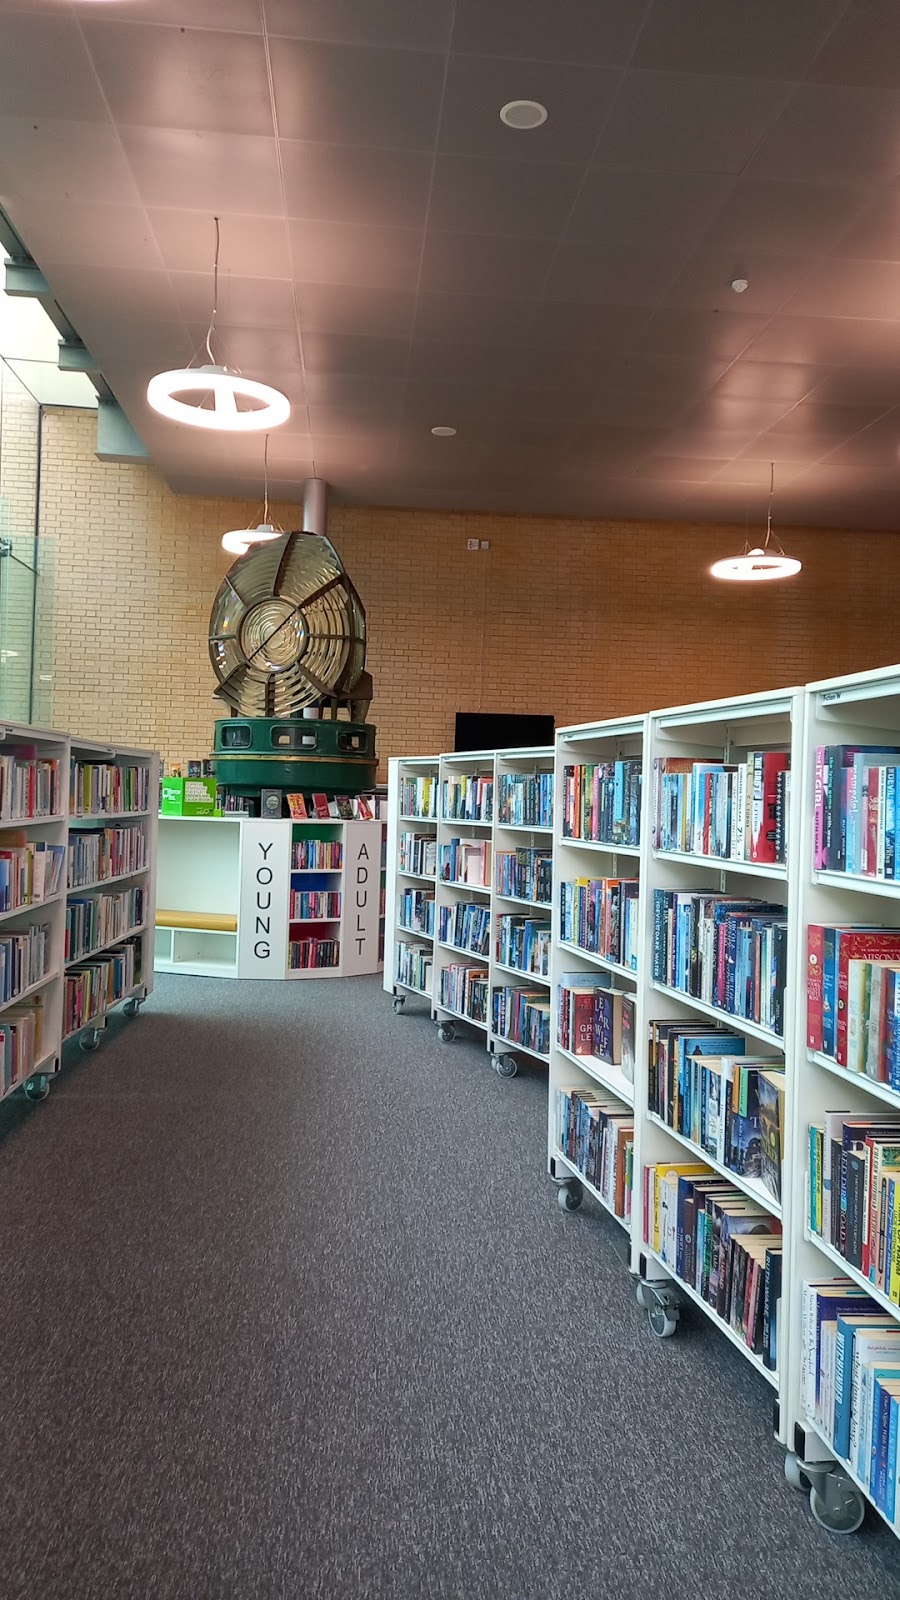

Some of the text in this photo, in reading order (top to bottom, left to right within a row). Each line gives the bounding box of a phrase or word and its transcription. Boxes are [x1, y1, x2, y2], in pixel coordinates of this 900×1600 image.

[754, 756, 762, 770] THE
[815, 764, 822, 776] IT
[754, 771, 762, 793] DRIFT
[254, 842, 273, 959] YOUNG
[355, 843, 370, 956] ADULT
[817, 1182, 820, 1194] ME
[834, 1332, 845, 1404] WITCHFINDER
